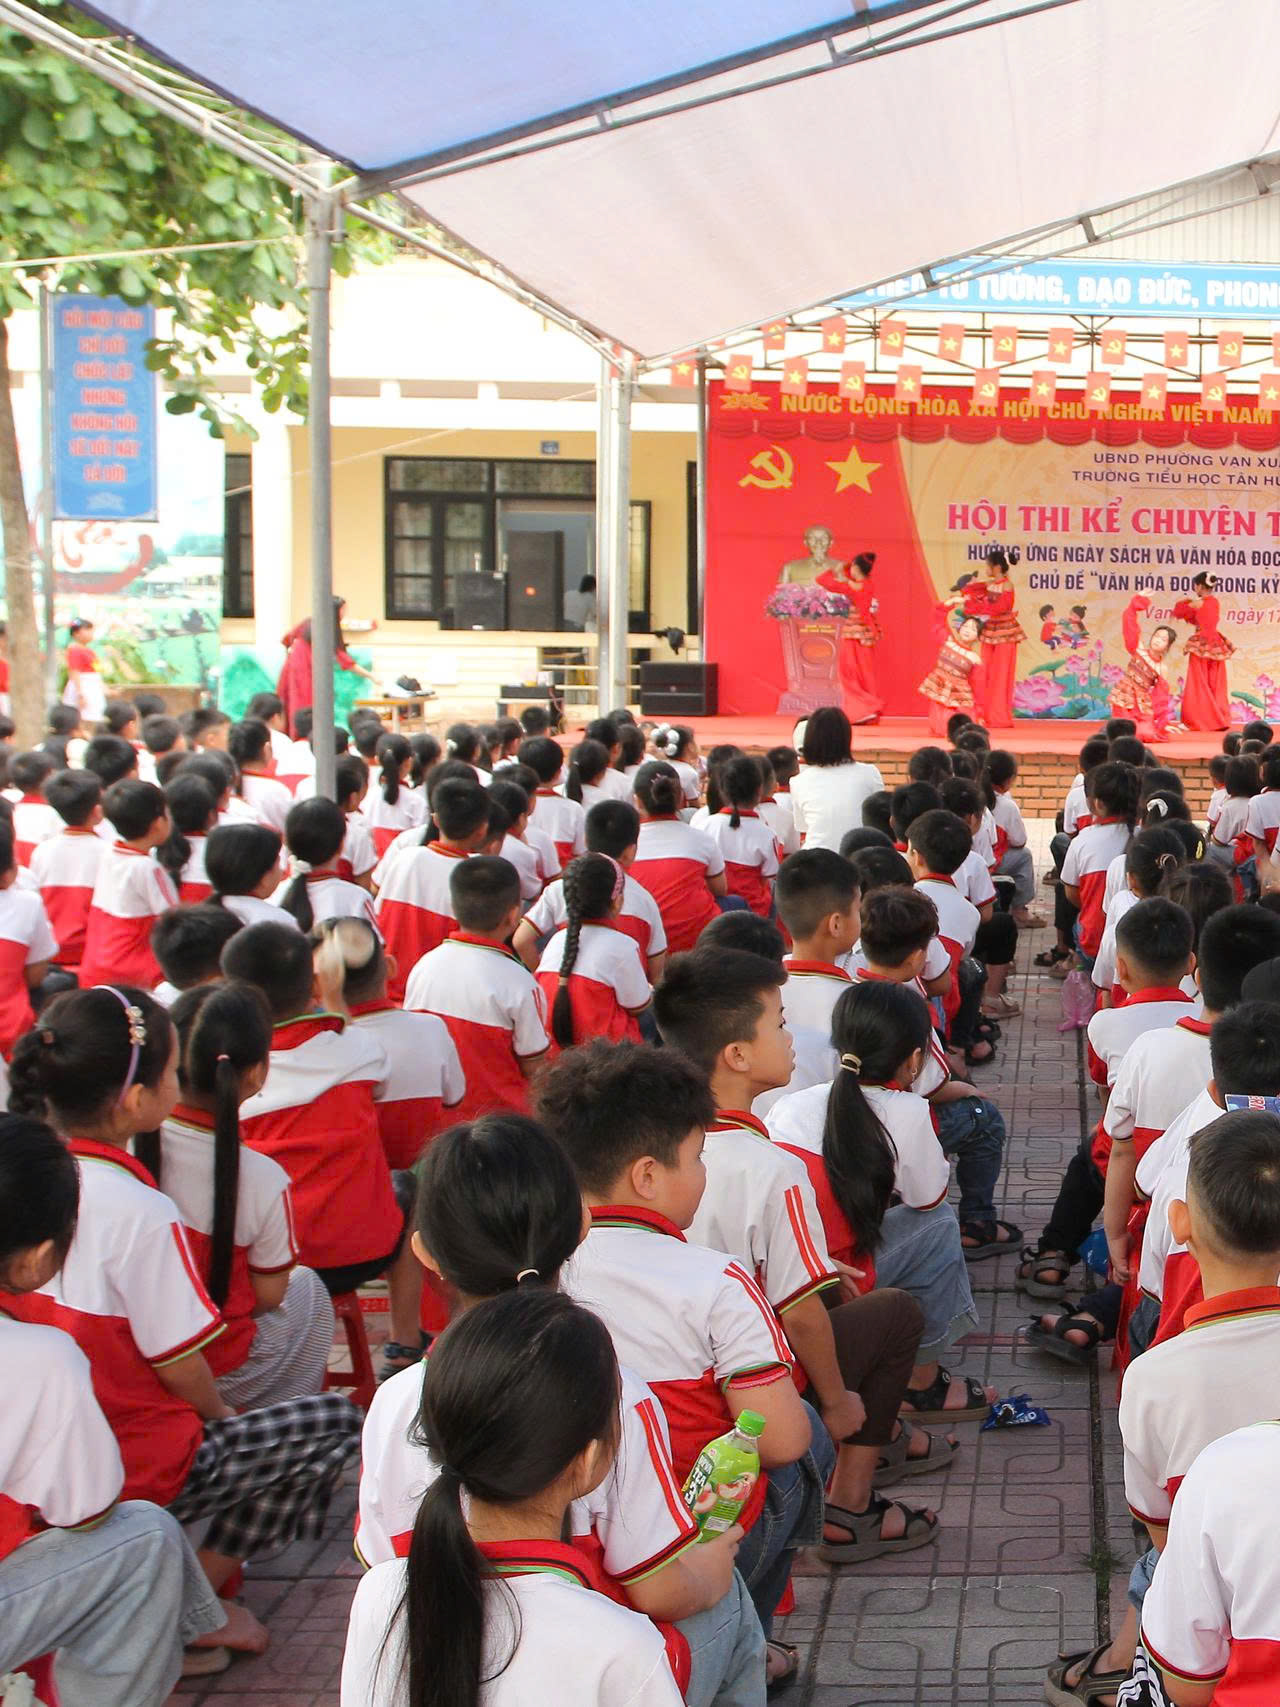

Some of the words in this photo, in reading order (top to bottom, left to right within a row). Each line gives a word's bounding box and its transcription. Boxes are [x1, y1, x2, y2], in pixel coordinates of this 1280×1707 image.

[1078, 276, 1131, 308] ĐẠO
[1138, 272, 1199, 308] ĐỨC,
[781, 391, 842, 413] NƯỚC
[849, 393, 910, 418] CỘNG
[916, 394, 961, 416] HÒA
[1223, 407, 1272, 424] NAM
[1094, 453, 1139, 464] UBND
[1145, 452, 1213, 466] PHƯỜNG
[1219, 456, 1251, 469] VẠN
[1072, 468, 1140, 482] TRƯỜNG
[1146, 467, 1181, 483] TIỂU
[1187, 474, 1221, 486] HỌC
[1228, 473, 1258, 485] TÂN
[948, 500, 1007, 536] HỘI
[1019, 506, 1070, 532] THI
[1082, 497, 1122, 533] KỂ
[1131, 504, 1256, 541] CHUYỆN
[1027, 543, 1058, 561] ỨNG
[1064, 544, 1104, 562] NGÀY
[1110, 544, 1151, 564] SÁCH
[1157, 545, 1175, 564] VÀ
[1181, 546, 1211, 565] VĂN
[1216, 547, 1246, 566] HÓA
[1251, 551, 1280, 570] ĐỌC
[1030, 569, 1060, 589] CHỦ
[1135, 573, 1165, 591] HÓA
[1214, 577, 1256, 593] RONG
[1261, 573, 1280, 594] KỶ
[1226, 608, 1264, 625] ngày
